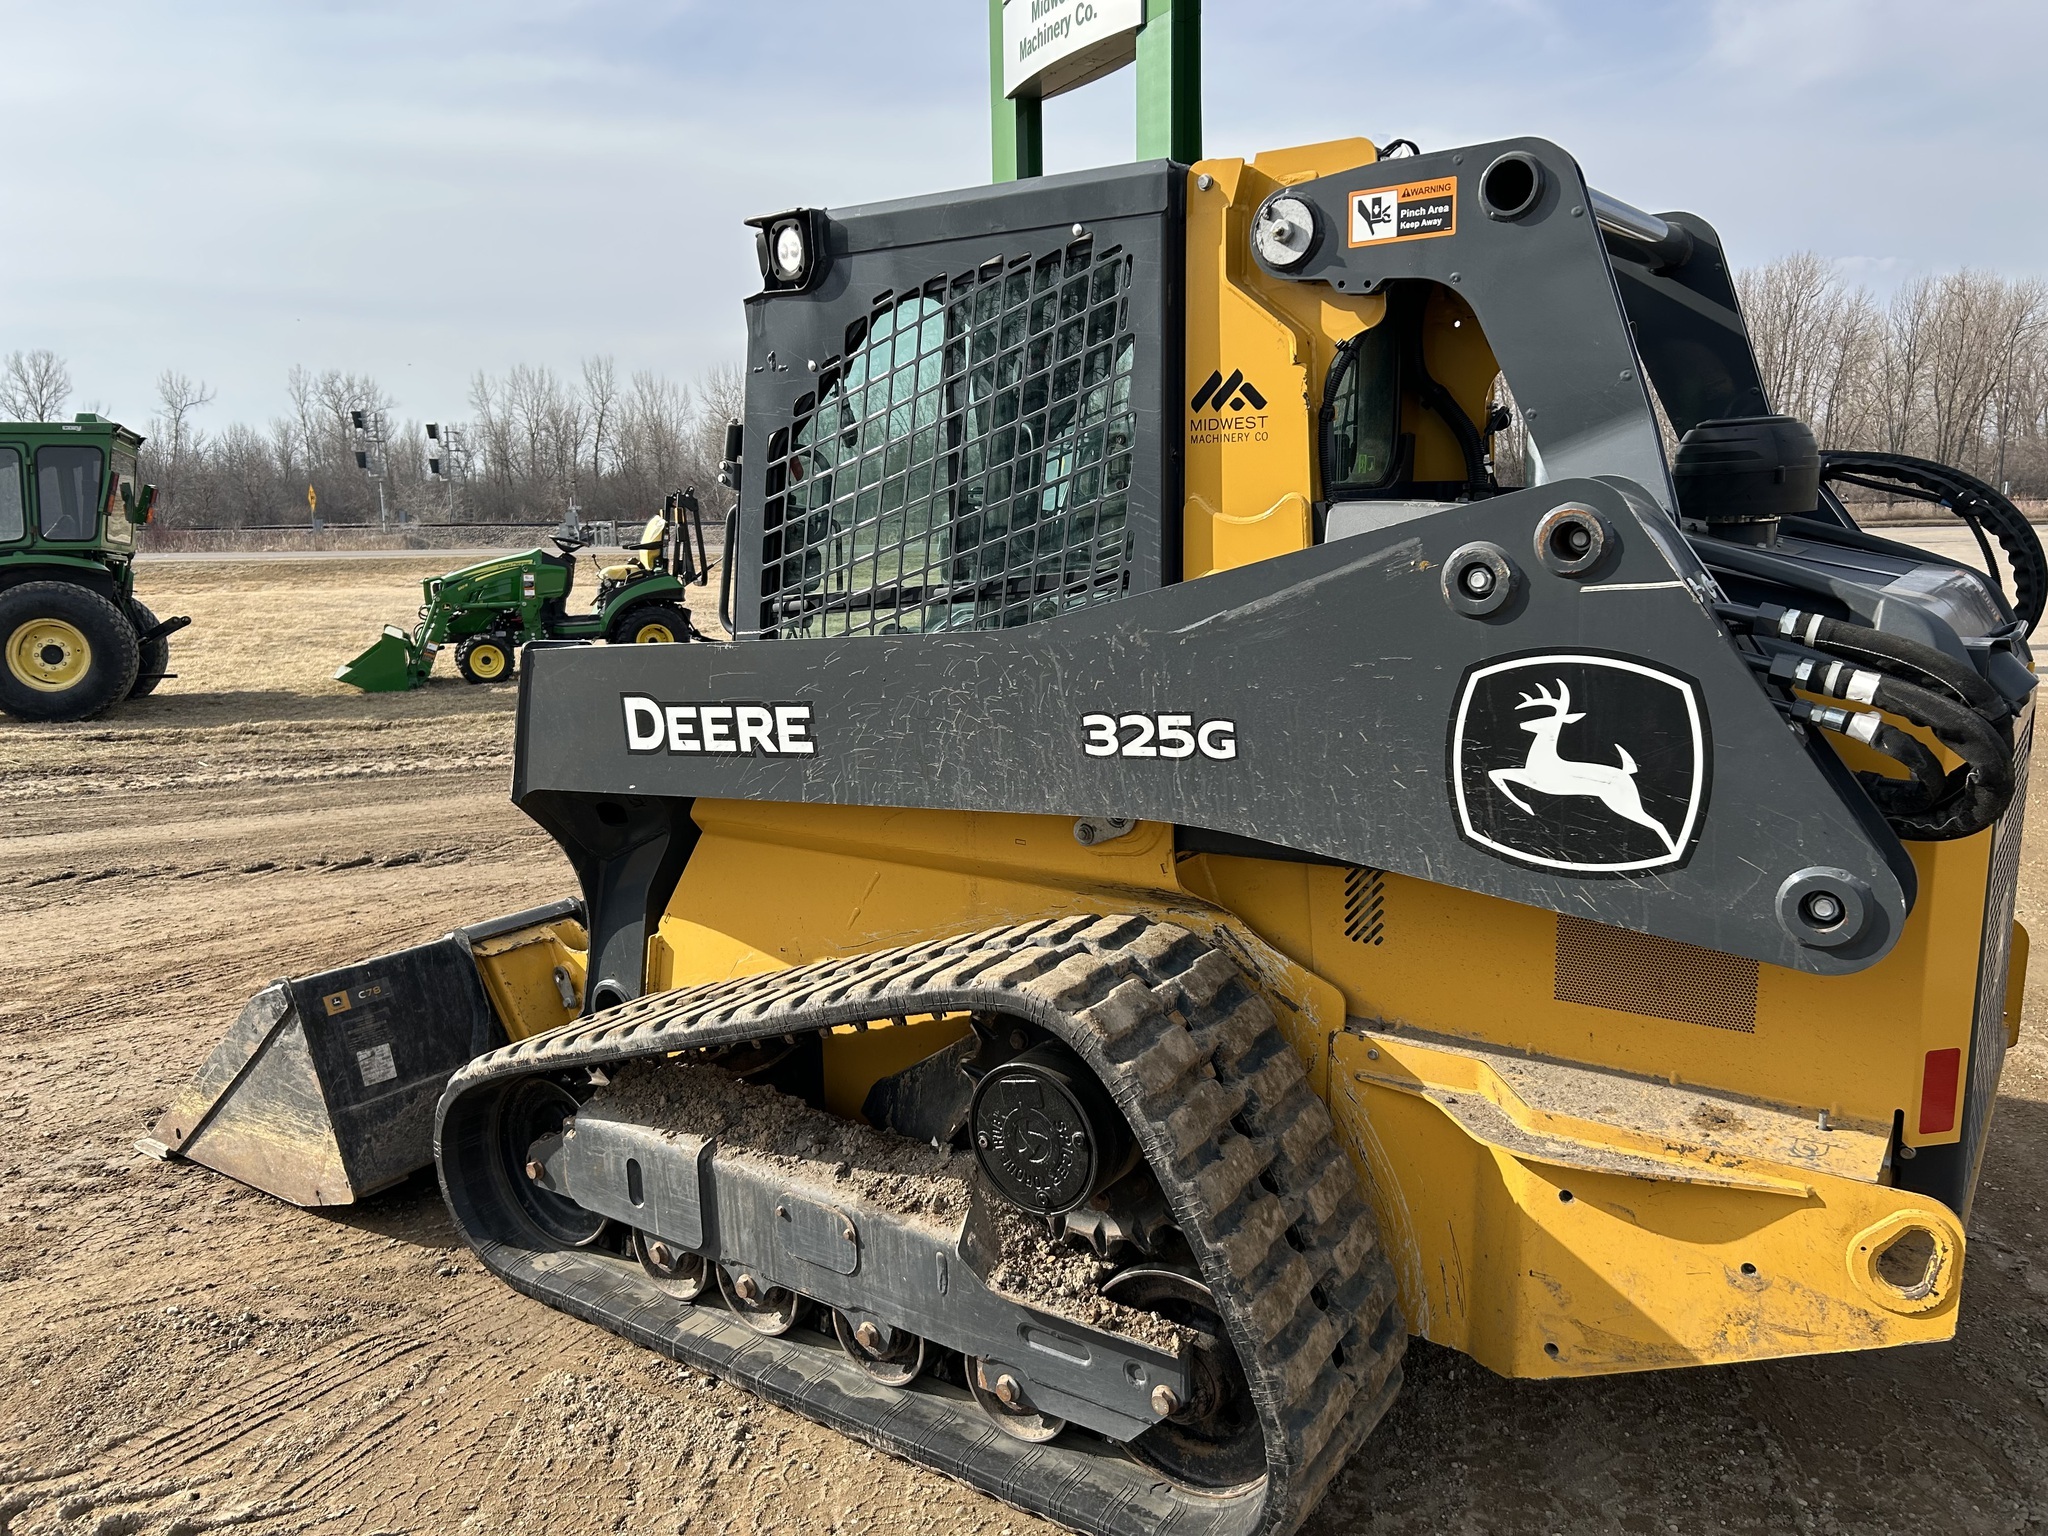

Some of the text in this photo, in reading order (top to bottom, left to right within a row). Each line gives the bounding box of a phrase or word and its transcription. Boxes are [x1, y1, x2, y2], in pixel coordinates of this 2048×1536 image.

[1019, 2, 1098, 63] Machinery Co.
[1409, 183, 1452, 196] WARNING
[1400, 204, 1450, 218] Pinch Area
[1400, 217, 1443, 230] Keep Away
[1190, 415, 1269, 432] MIDWEST
[1190, 431, 1269, 445] MACHINERY CO
[623, 696, 815, 753] DEERE
[1082, 714, 1237, 760] 325G
[358, 985, 382, 999] C78
